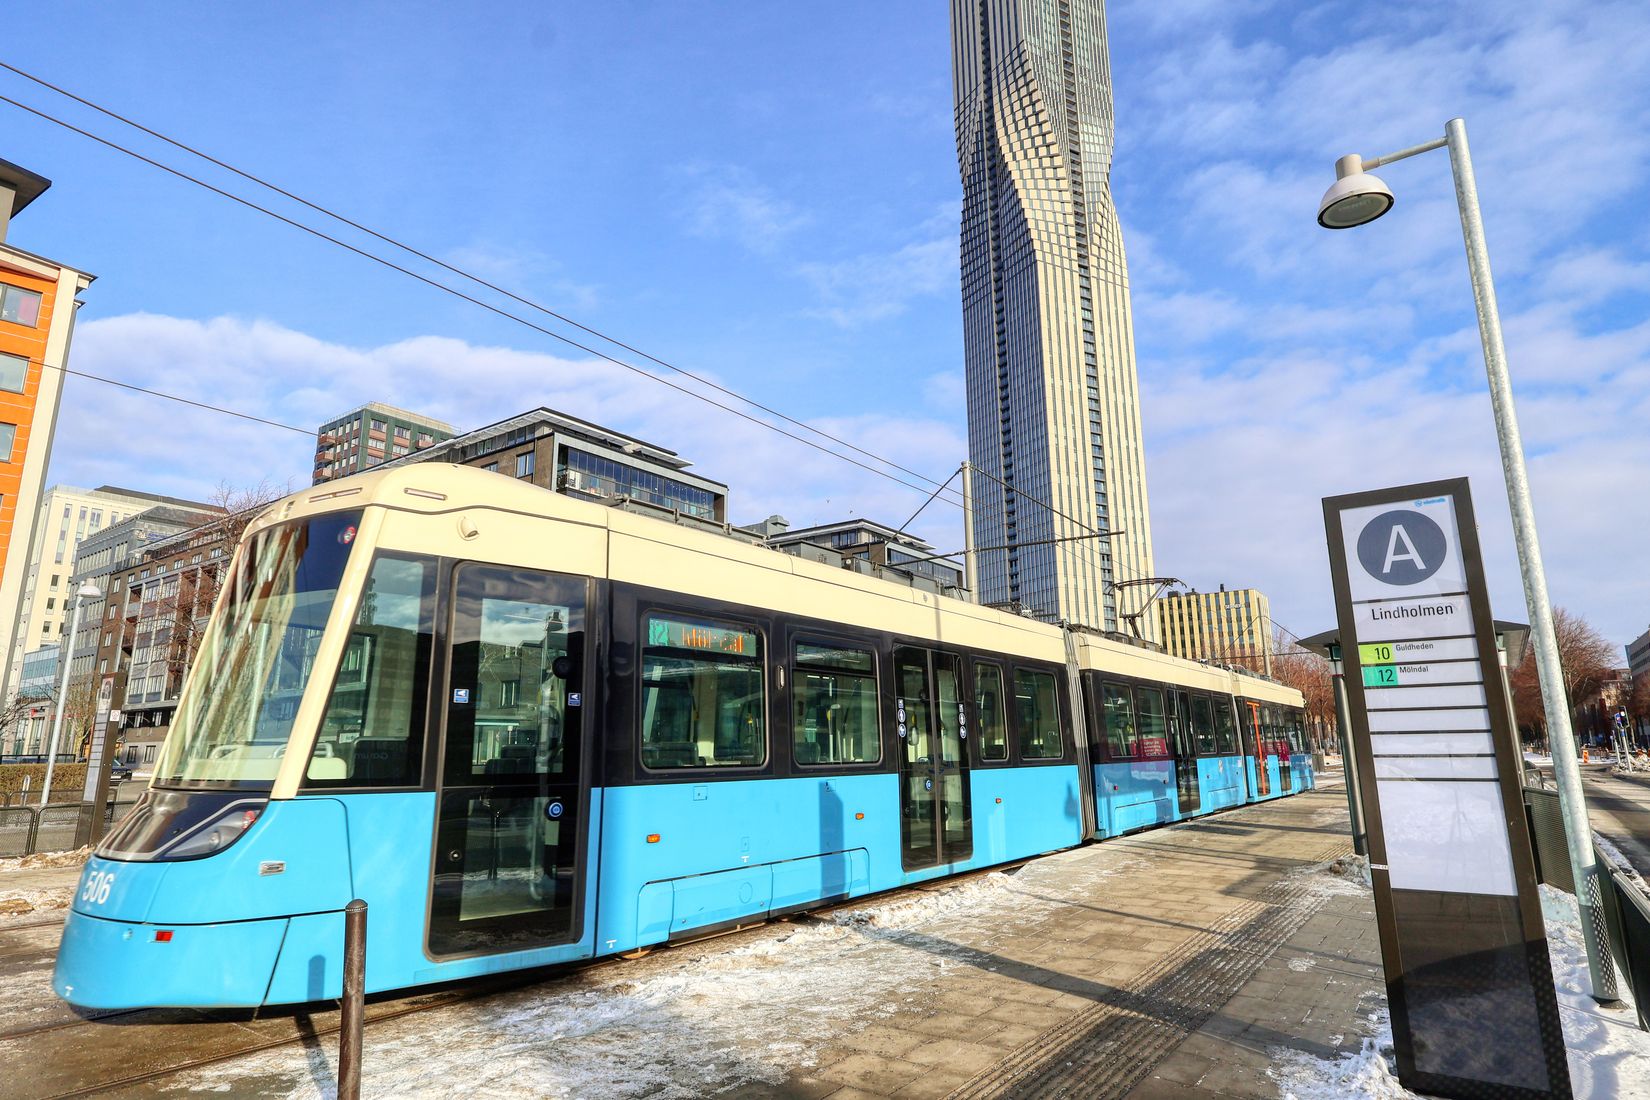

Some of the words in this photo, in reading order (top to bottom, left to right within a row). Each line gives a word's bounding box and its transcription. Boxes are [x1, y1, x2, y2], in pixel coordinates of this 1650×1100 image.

[1382, 524, 1427, 574] A
[1372, 604, 1453, 621] Lindholmen
[1374, 646, 1391, 660] 10
[1395, 643, 1434, 651] Guldheden
[1378, 669, 1394, 683] 12
[1399, 665, 1429, 673] Mölndal
[83, 871, 114, 904] 506
